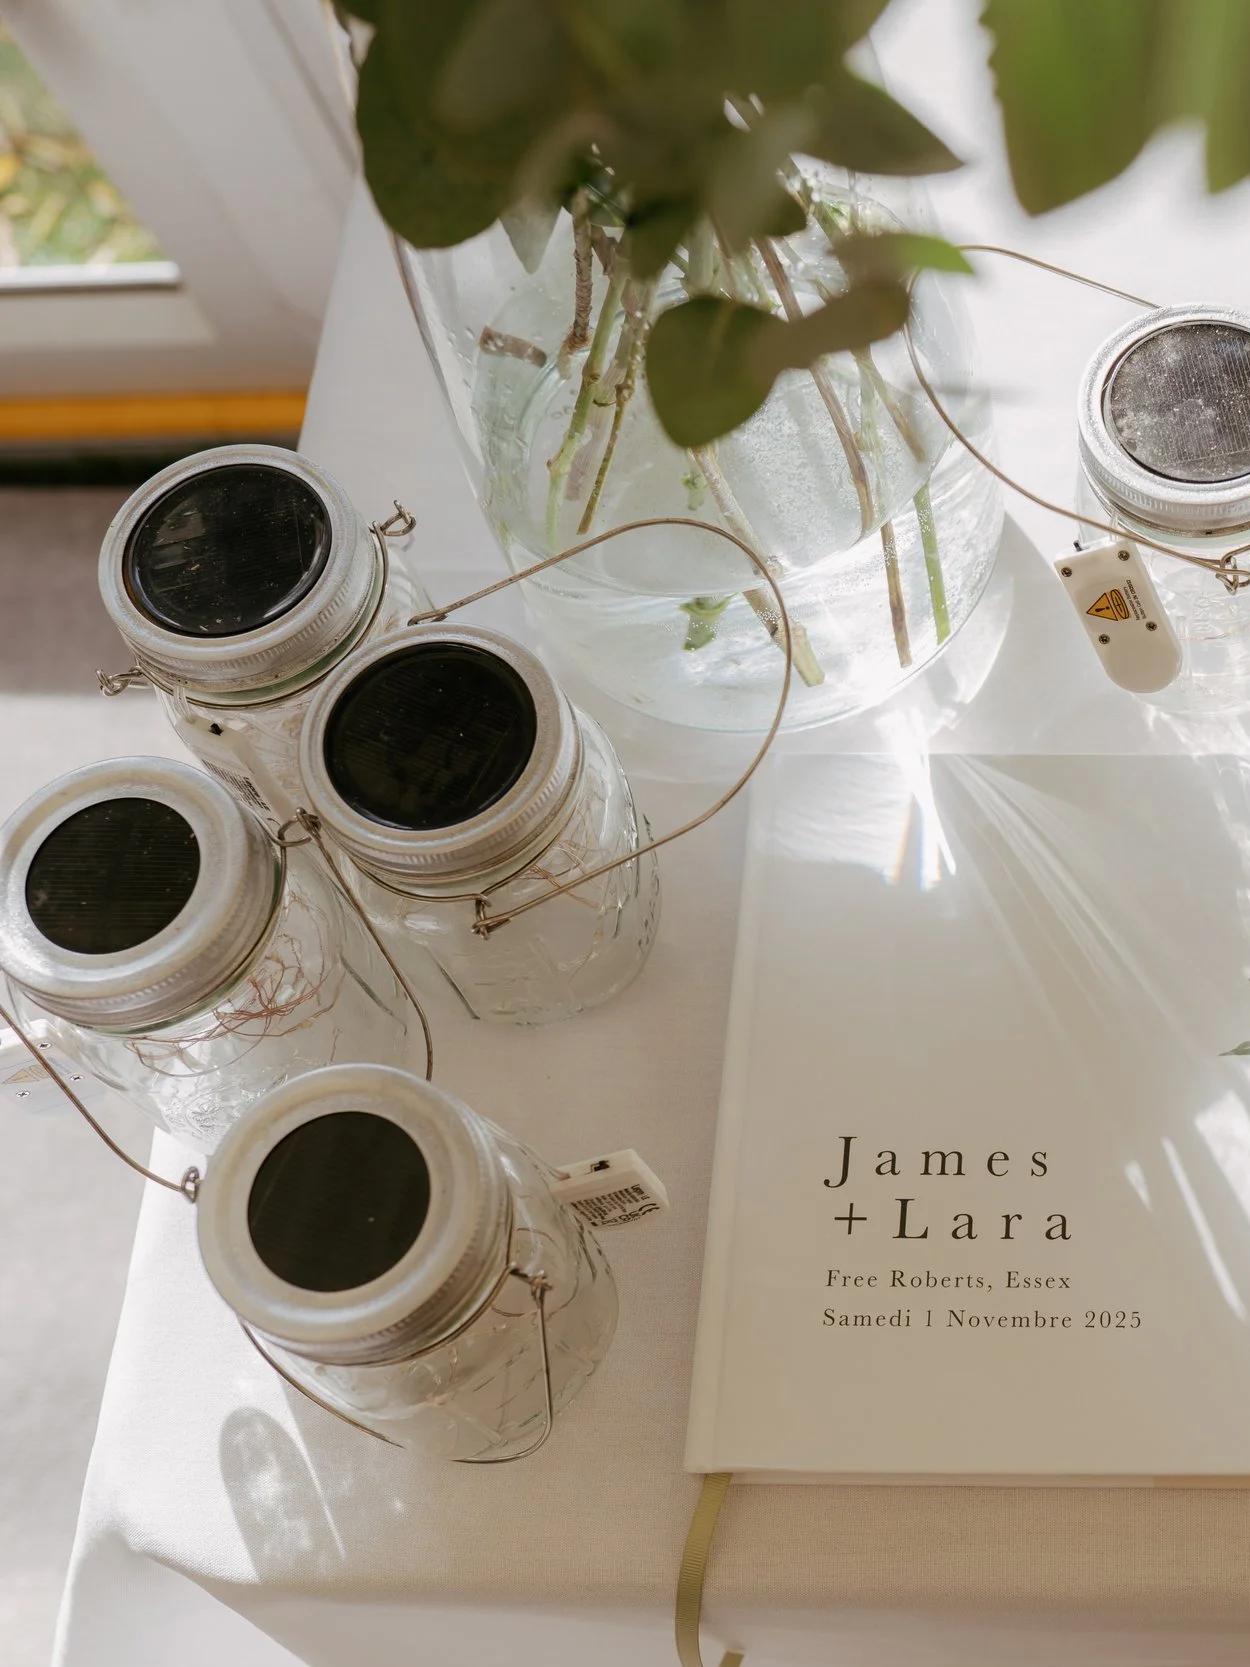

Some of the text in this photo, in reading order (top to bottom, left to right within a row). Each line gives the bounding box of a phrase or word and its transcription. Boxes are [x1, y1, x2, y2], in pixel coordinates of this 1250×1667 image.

[823, 1136, 1050, 1189] James
[826, 1269, 1071, 1293] Free Roberts, Essex
[823, 1308, 911, 1327] Samedi
[946, 1309, 1073, 1328] Novembre
[1084, 1311, 1142, 1329] 2025
